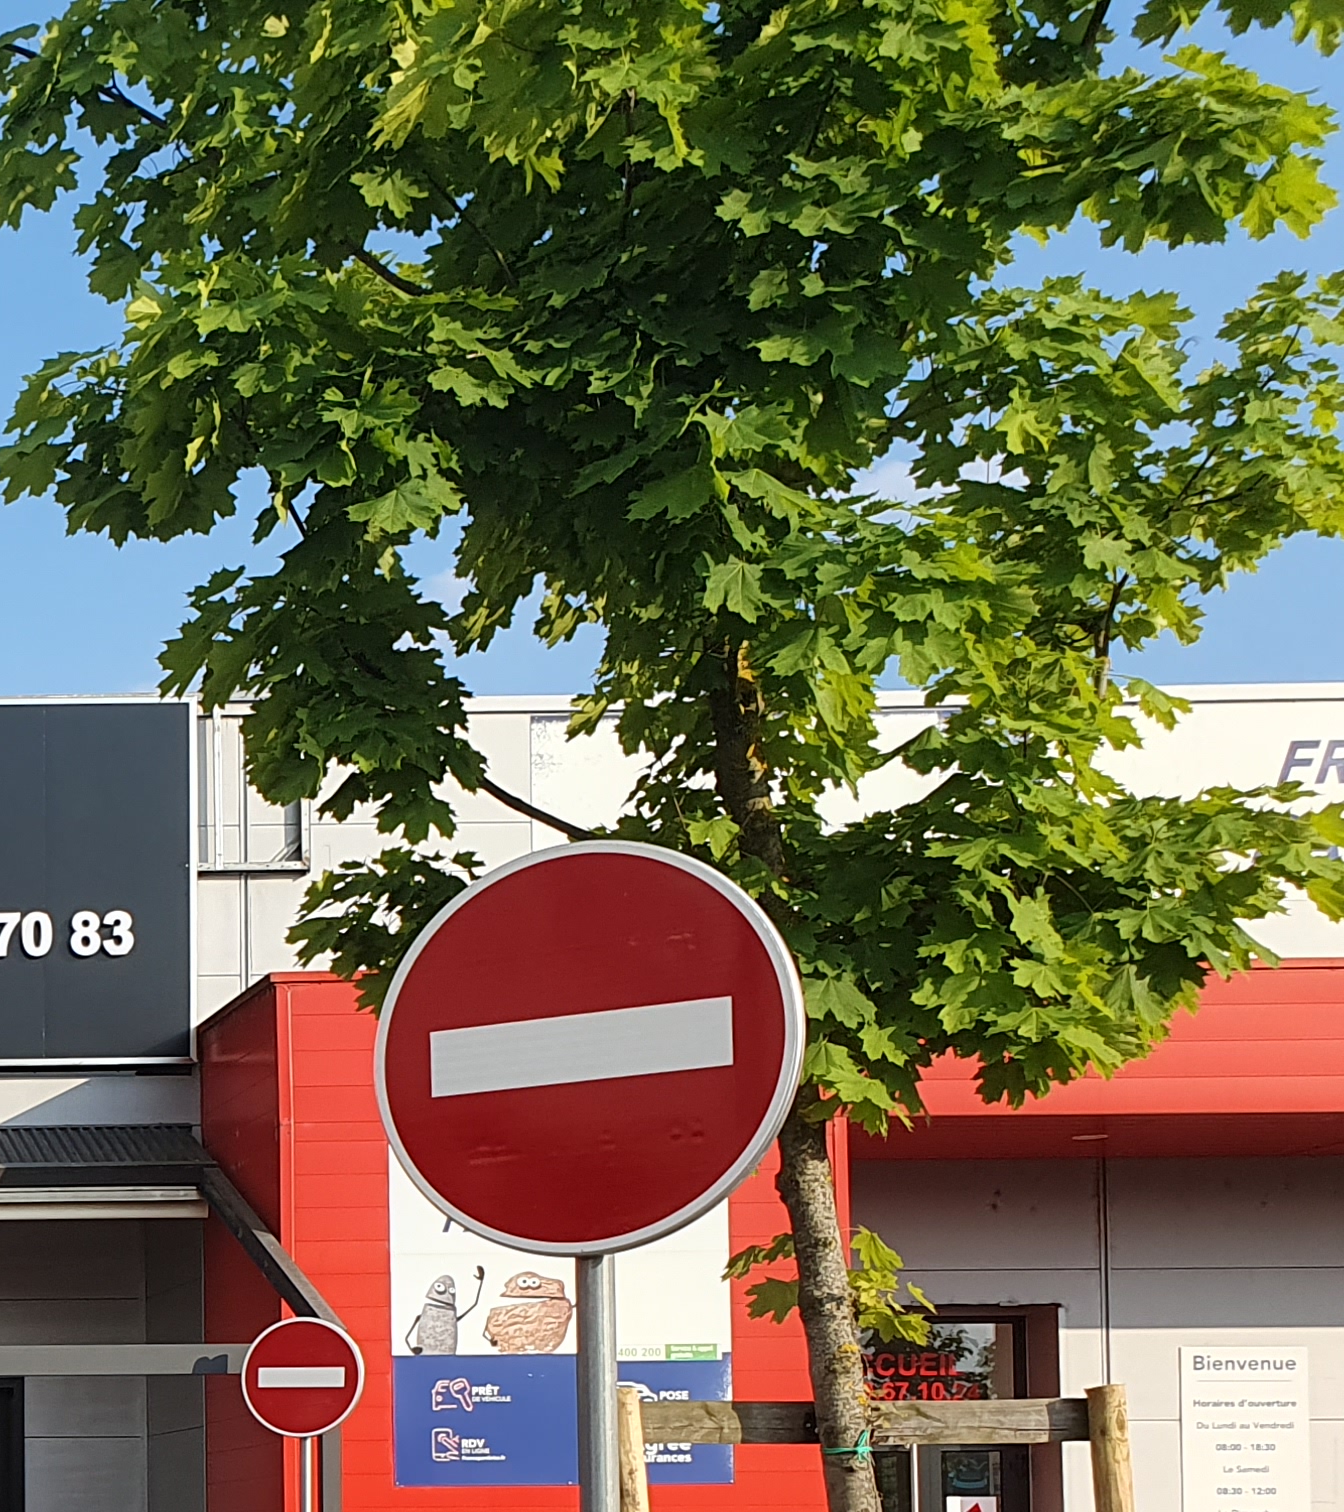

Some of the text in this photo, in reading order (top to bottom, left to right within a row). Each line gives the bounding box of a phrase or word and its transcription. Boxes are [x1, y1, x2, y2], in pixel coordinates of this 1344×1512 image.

[69, 910, 135, 956] 83
[642, 1347, 661, 1357] 200
[864, 1352, 963, 1376] CUEIL
[1192, 1354, 1297, 1371] Bienvenue
[472, 1383, 500, 1396] PRÊT
[659, 1391, 689, 1400] POSE
[1193, 1399, 1235, 1407] Horaires
[1196, 1421, 1209, 1430] Du
[1212, 1421, 1236, 1430] Lundi
[1252, 1421, 1295, 1429] Vendredi
[461, 1439, 485, 1448] RDV
[1223, 1465, 1270, 1473] Le Samedi
[1251, 1487, 1277, 1495] 12:00
